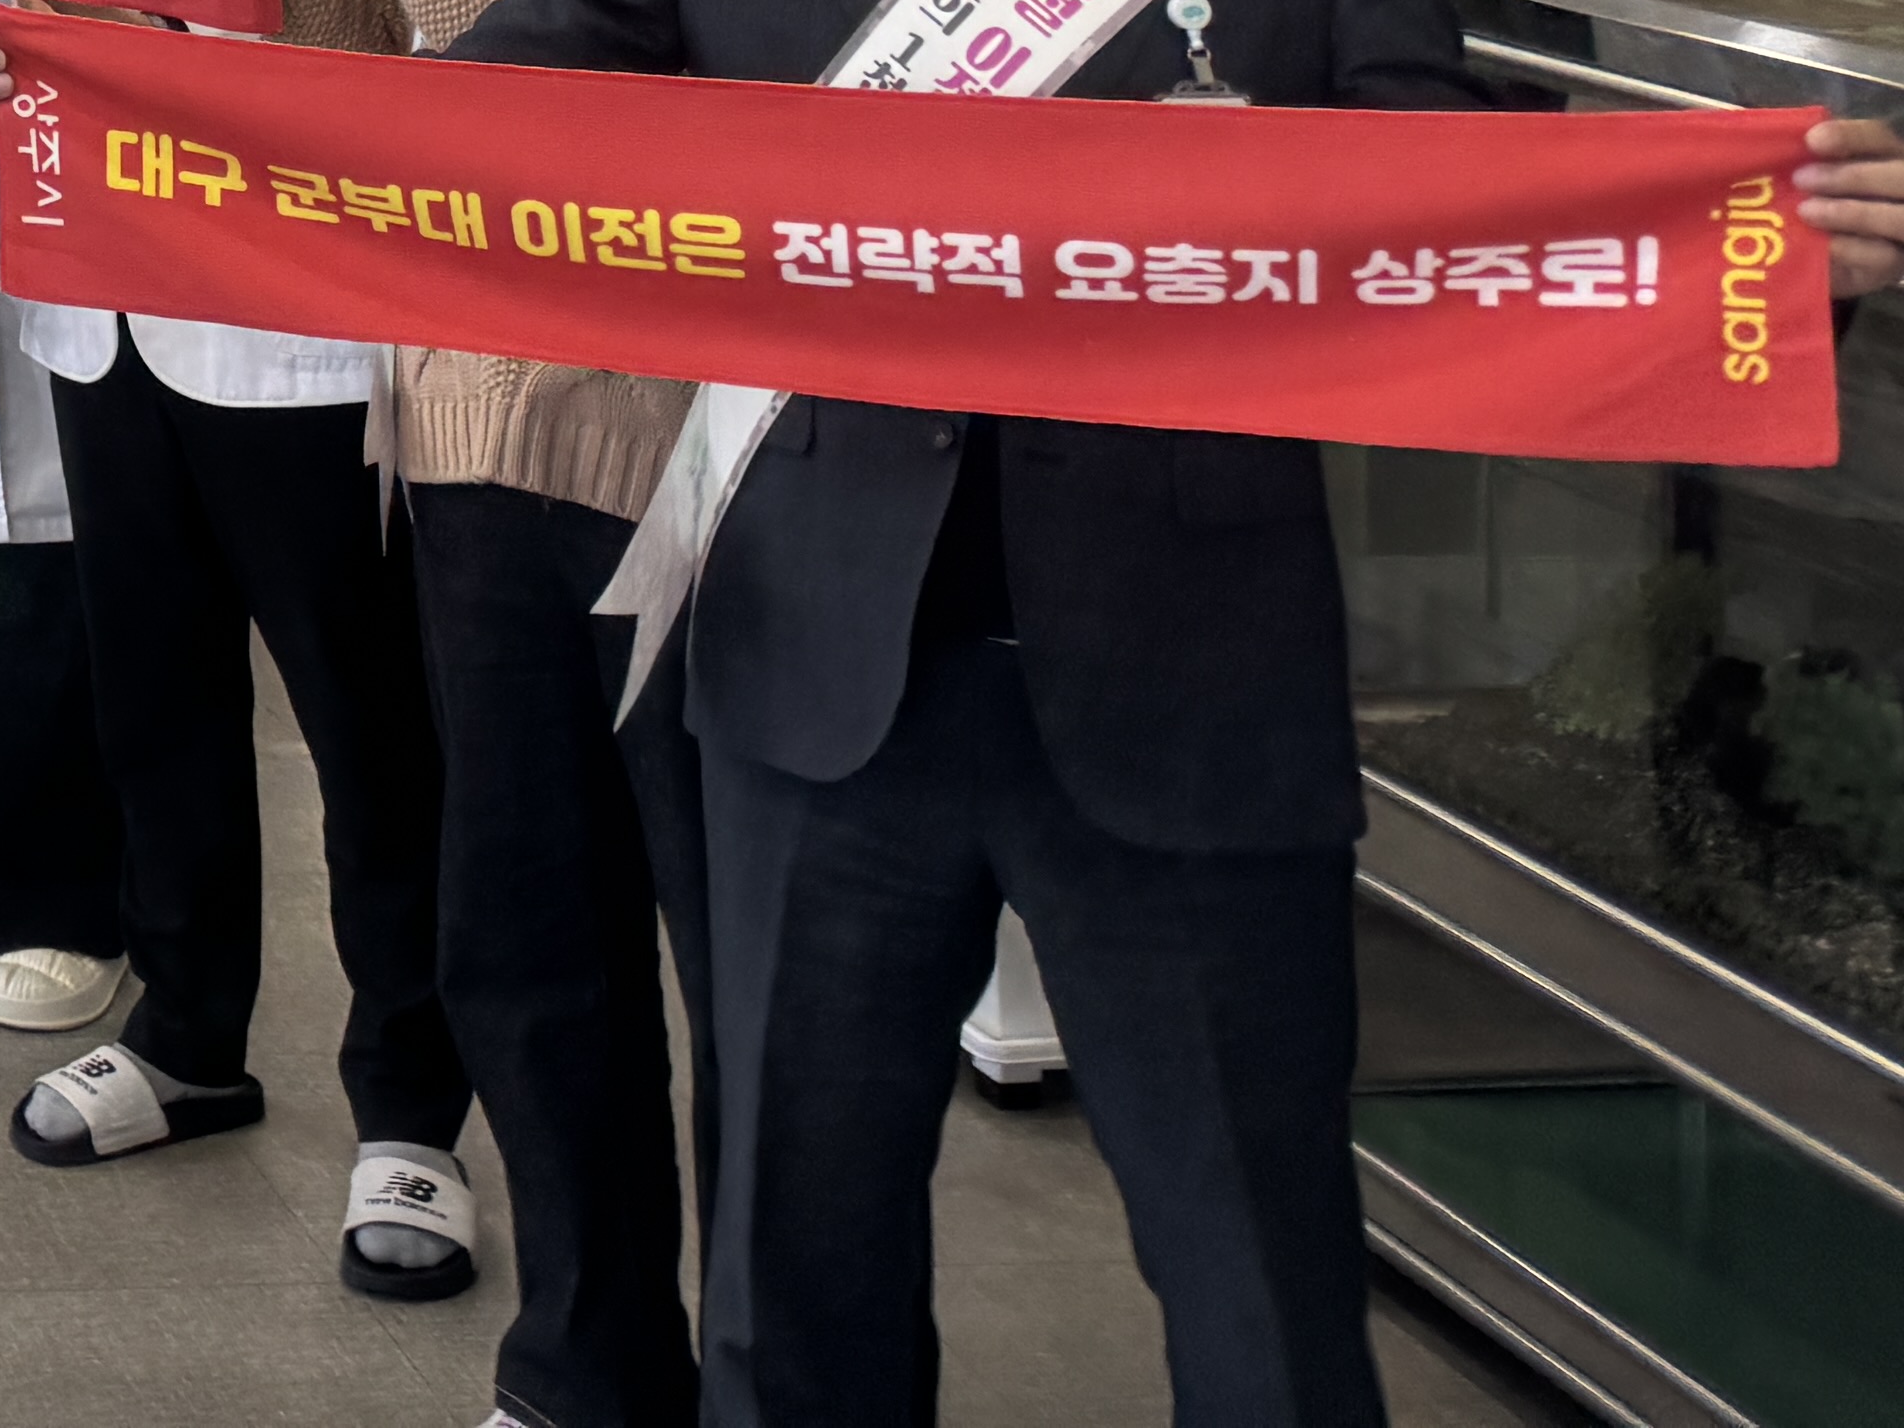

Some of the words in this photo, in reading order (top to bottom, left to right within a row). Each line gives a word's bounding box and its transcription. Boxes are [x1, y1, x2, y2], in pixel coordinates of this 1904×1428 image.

[12, 80, 65, 228] 상주시
[105, 127, 248, 207] 대구
[267, 163, 490, 251] 군부대
[512, 198, 747, 280] 이전은
[772, 218, 1025, 300] 전략적
[1054, 239, 1319, 306] 요충지
[1350, 235, 1662, 309] 상주로!
[1710, 175, 1786, 386] sangju
